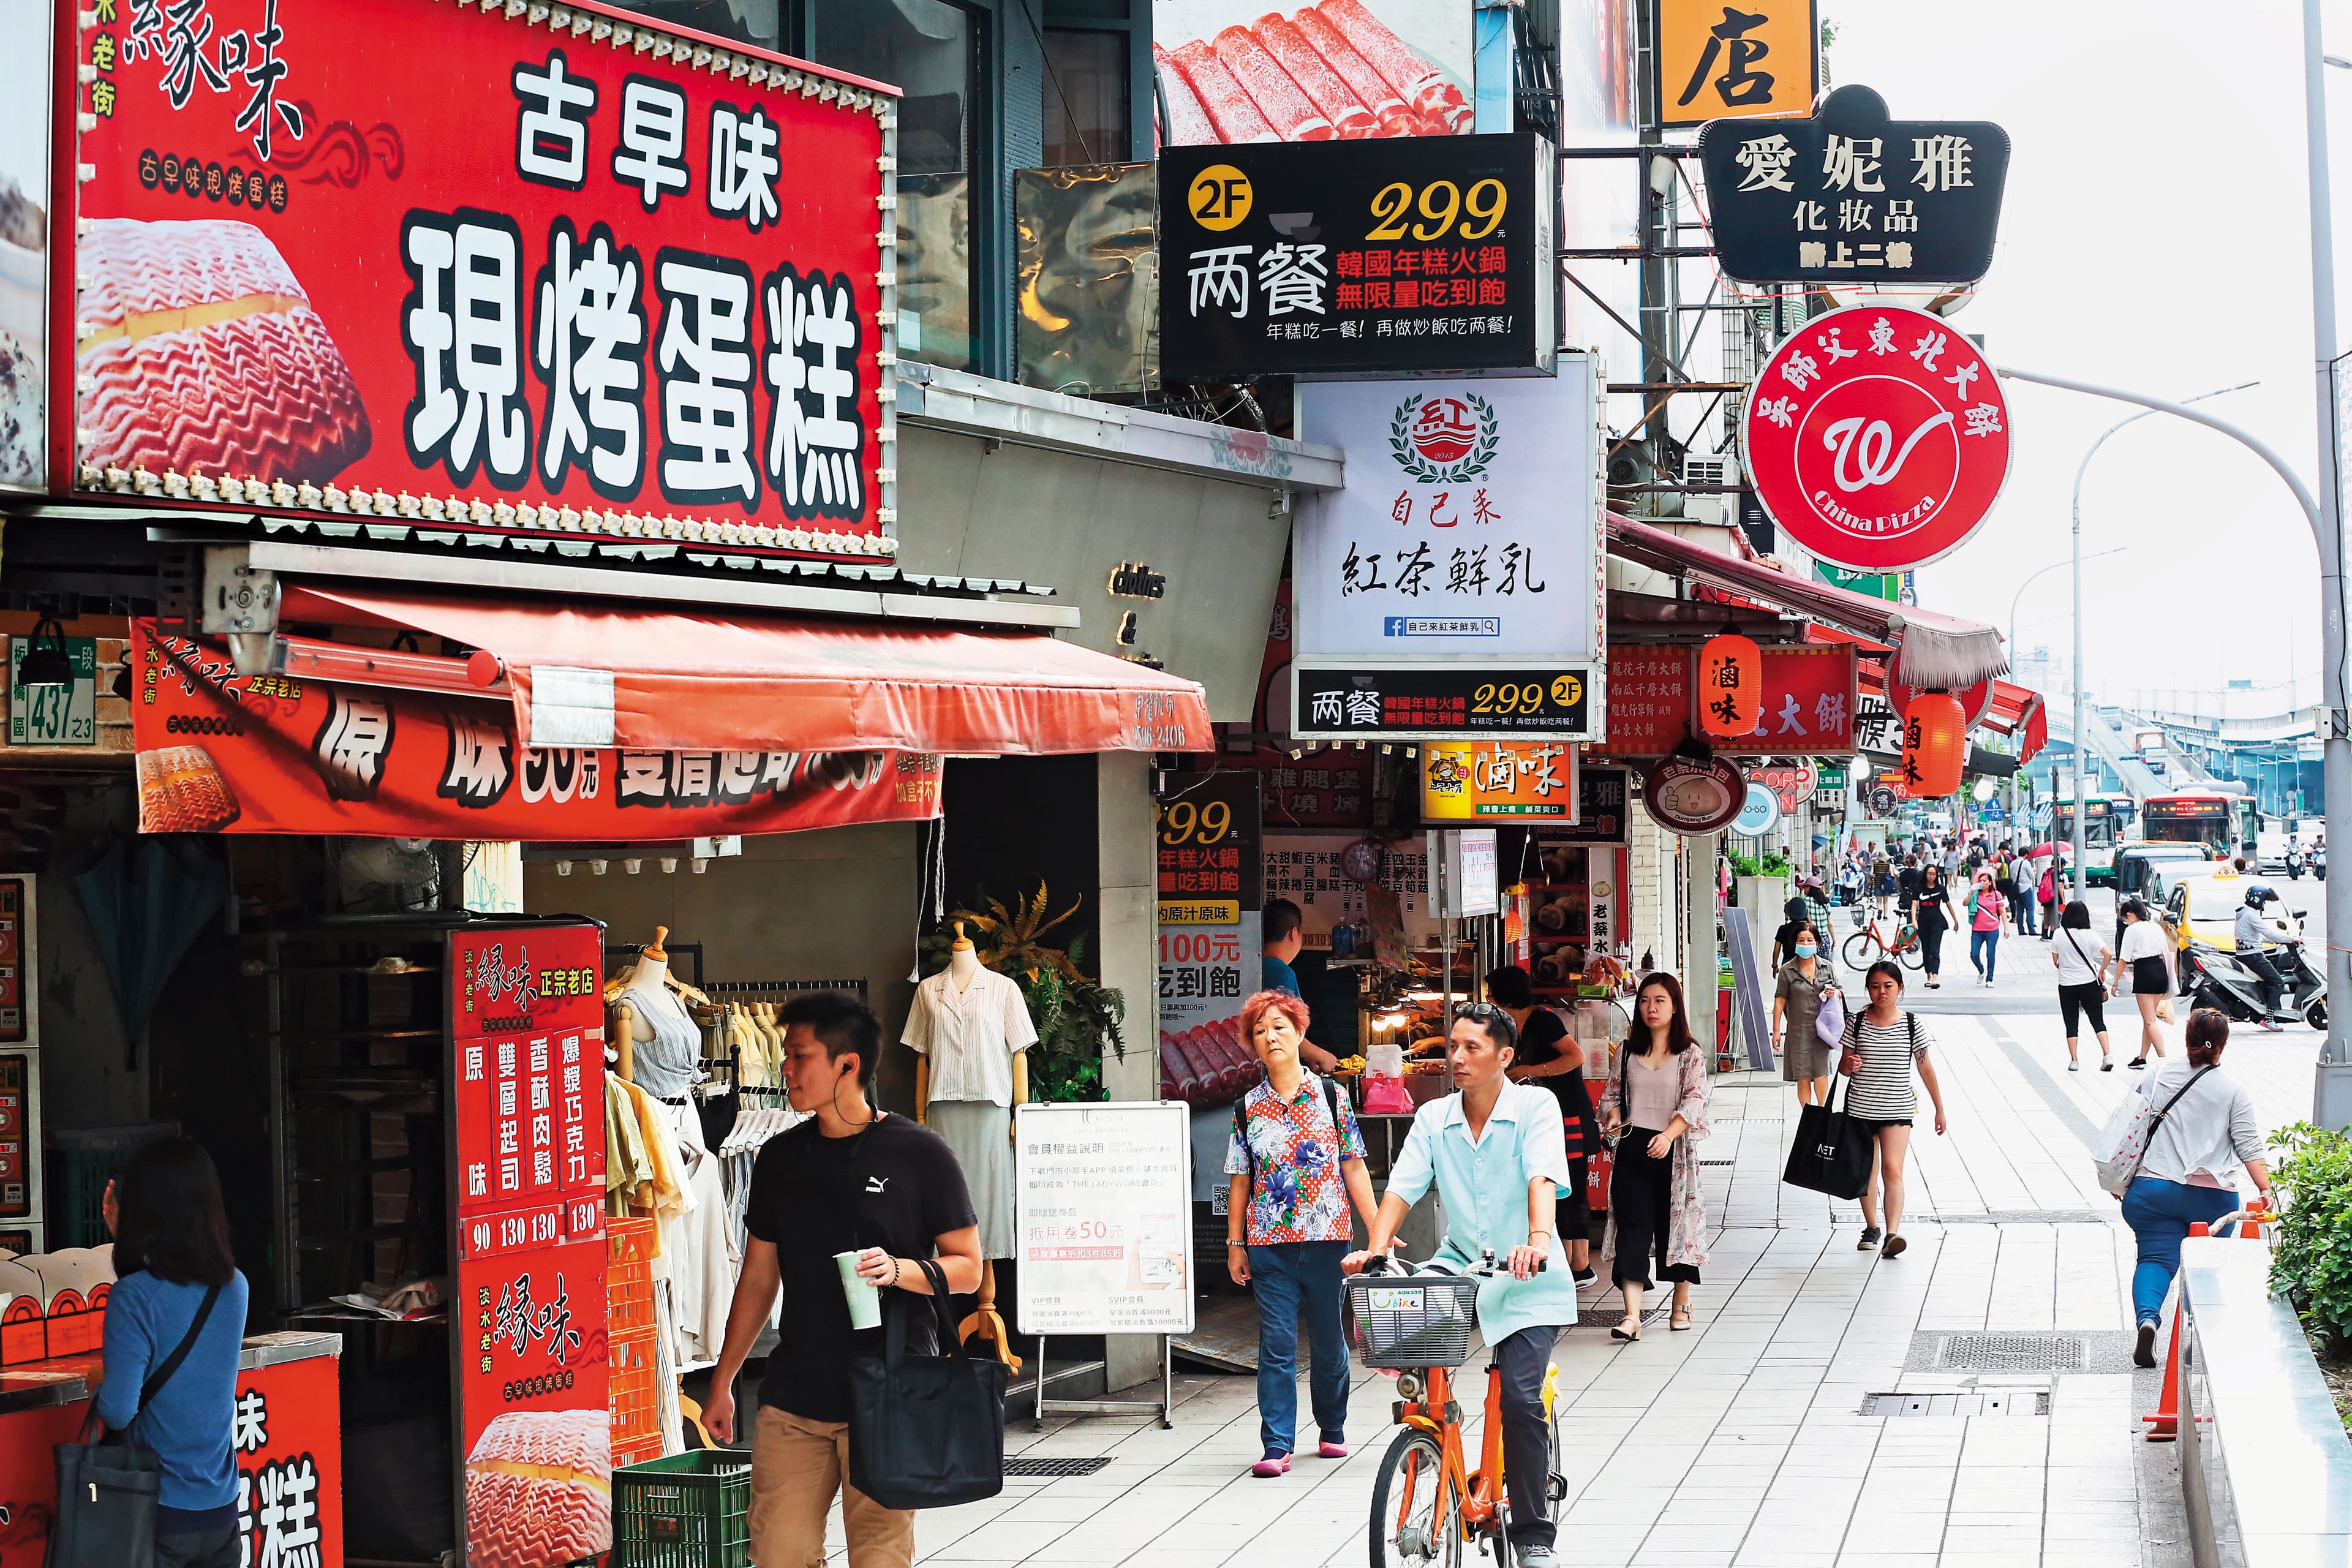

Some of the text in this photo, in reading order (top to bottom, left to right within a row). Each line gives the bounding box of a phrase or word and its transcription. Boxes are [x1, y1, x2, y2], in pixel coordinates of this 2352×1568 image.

[1678, 7, 1775, 107] 店
[514, 54, 779, 229] 古早味
[1735, 134, 1974, 192] 愛妮雅
[141, 151, 287, 210] 古早味現烤蛋糕
[1196, 178, 1247, 219] 2F
[1365, 178, 1507, 241] 299
[1793, 199, 1918, 233] 化妝品
[1336, 246, 1506, 279] 韓國年糕火鍋
[1336, 279, 1506, 310] 無限量吃到飽
[404, 216, 862, 514] 現烤蛋糕
[1814, 489, 1936, 532] China Pizza
[1342, 541, 1546, 598] 紅茶鮮乳
[1408, 622, 1479, 633] 自己來紅茶鮮乳
[246, 674, 303, 701] 正宗老店
[1384, 696, 1466, 711] 韓國年糕火鍋
[1471, 683, 1544, 714] 299
[1553, 681, 1581, 702] 2F
[1710, 657, 1741, 725] 滷味
[1384, 711, 1466, 726] 無限量吃到飽
[1612, 723, 1654, 736] 山東大餅
[1474, 742, 1564, 796] 滷味
[1156, 801, 1231, 845] 99
[1675, 814, 1702, 823] Dumpling
[475, 943, 538, 1012] 緣味
[540, 968, 593, 997] 正宗老店
[497, 1042, 519, 1191] 雙層起司
[530, 1037, 552, 1186] 香酥肉鬆
[562, 1035, 586, 1183] 爆漿巧克力
[1028, 1143, 1104, 1156] 會員權益說明
[473, 1202, 595, 1253] 90 130 130 130
[479, 1286, 492, 1374] 淡水老街
[493, 1272, 580, 1366] 緣味
[504, 1370, 574, 1402] 古早味現烤蛋糕
